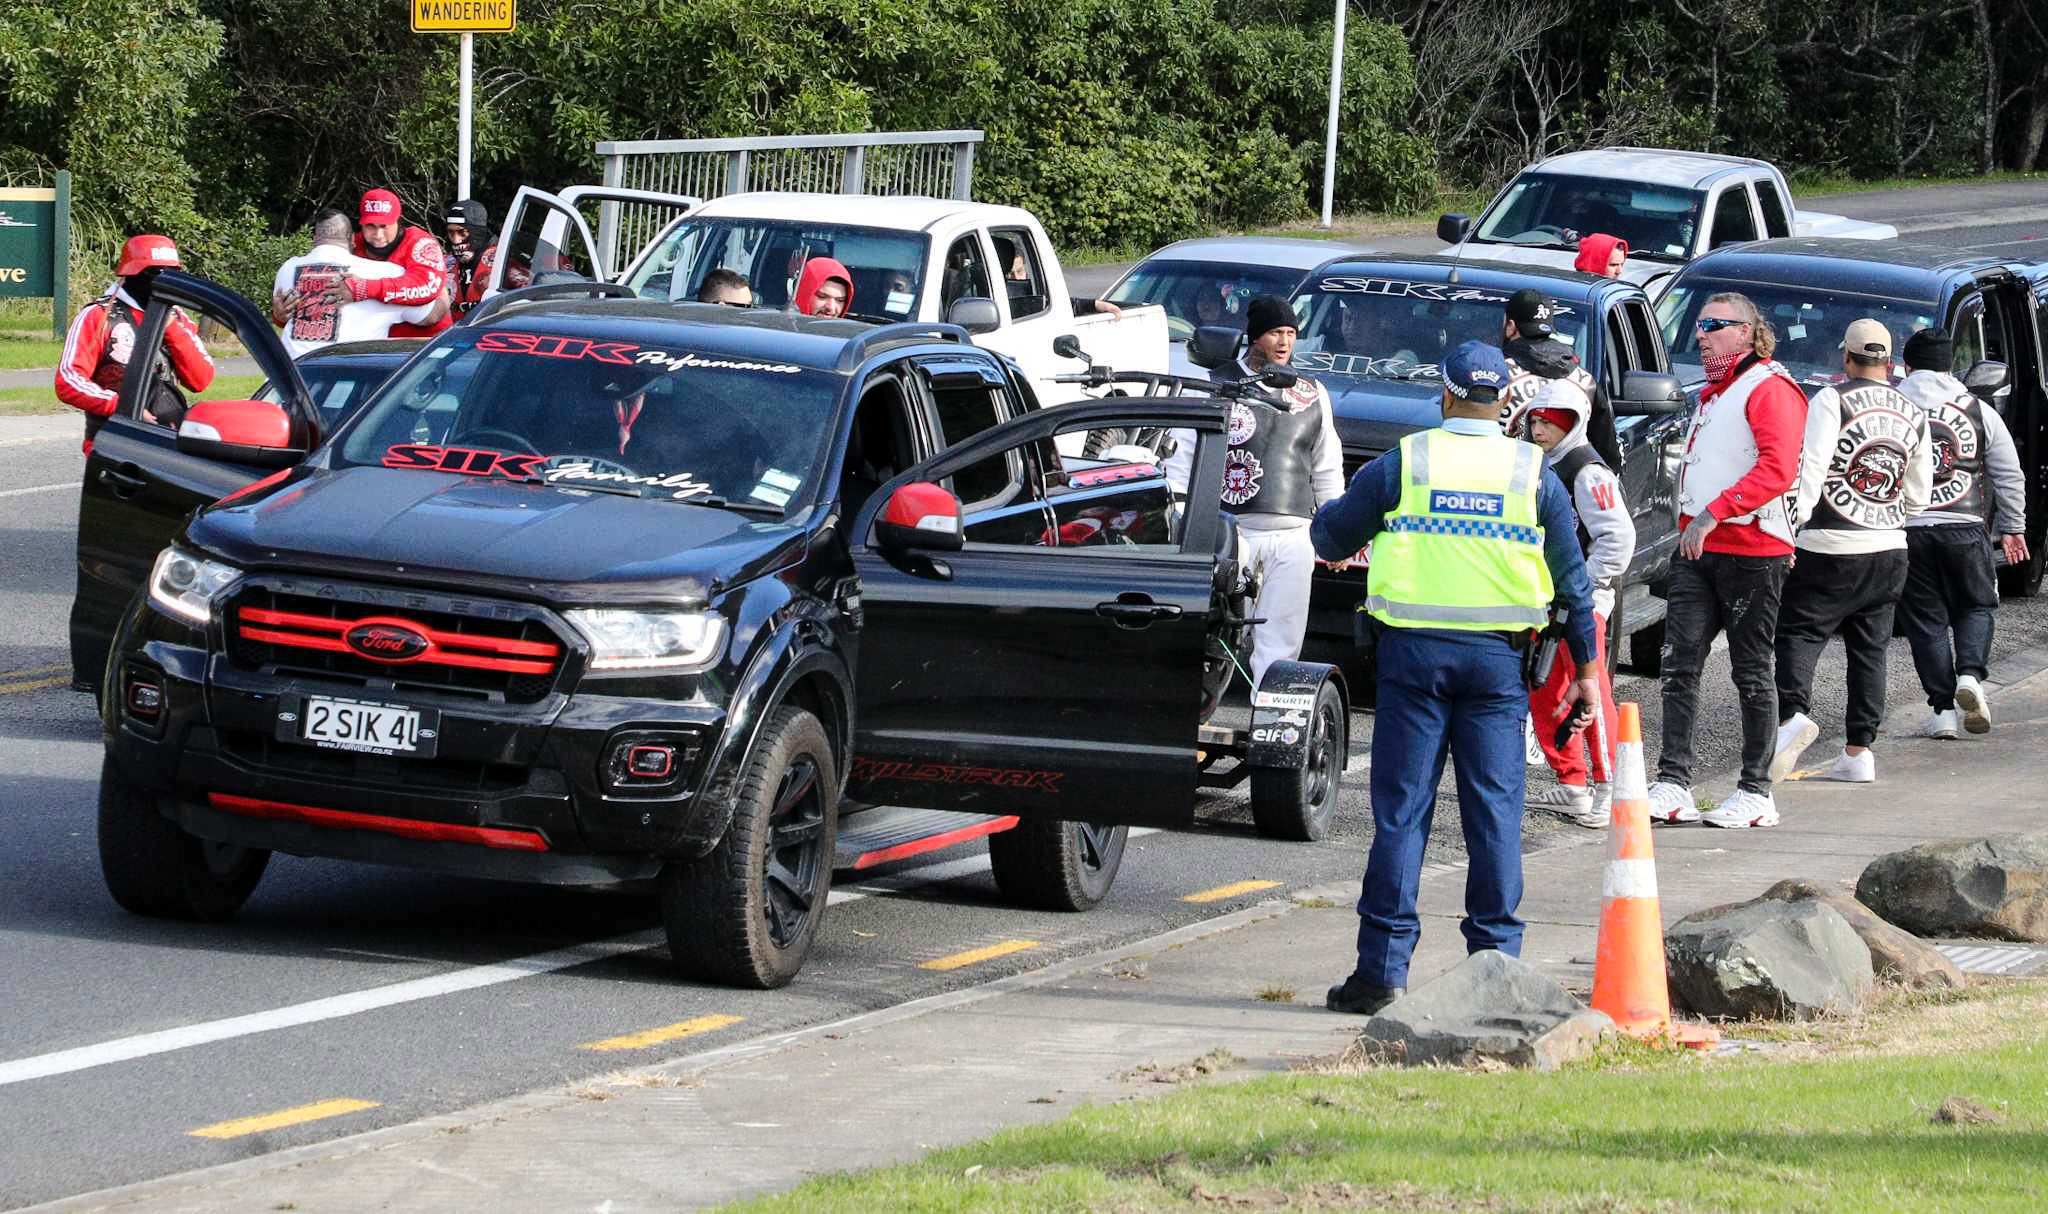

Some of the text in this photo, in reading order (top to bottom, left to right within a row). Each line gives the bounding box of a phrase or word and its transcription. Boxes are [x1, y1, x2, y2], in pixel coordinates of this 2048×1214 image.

[420, 1, 507, 20] WANDERING
[1319, 277, 1449, 301] SIK
[475, 332, 802, 373] SIK Performance
[1291, 351, 1407, 377] SIK
[1471, 369, 1501, 384] POLICE
[1845, 389, 1922, 423] MIGHTY
[1828, 415, 1915, 474] MONGREL
[1949, 414, 1976, 456] MOB
[381, 444, 552, 481] SIK
[545, 463, 714, 499] Family
[1435, 495, 1499, 512] POLICE
[1591, 481, 1616, 512] W
[1824, 478, 1907, 528] AOTEARO
[277, 582, 514, 618] RANGER
[361, 628, 407, 651] Ford
[317, 740, 393, 756] www.FAIRVIEW.co.nz
[1252, 728, 1282, 743] elf
